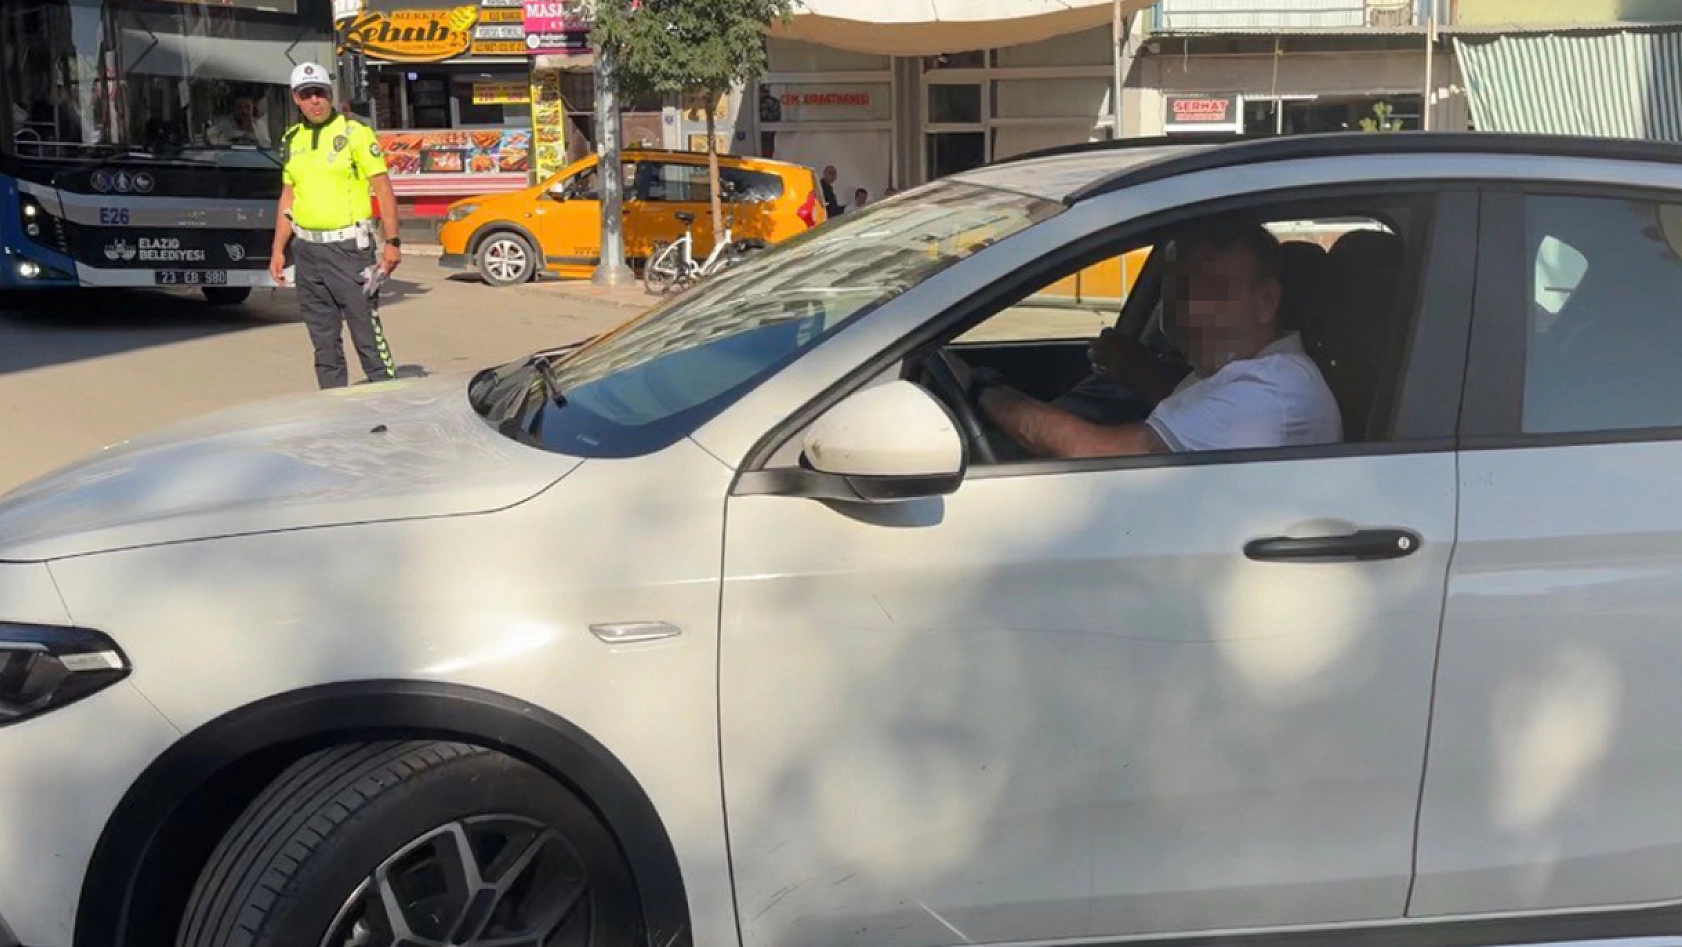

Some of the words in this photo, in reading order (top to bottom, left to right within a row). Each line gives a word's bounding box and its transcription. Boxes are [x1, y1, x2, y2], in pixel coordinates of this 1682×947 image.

[394, 12, 447, 20] MERKEZ
[449, 30, 468, 48] 23
[1174, 101, 1229, 111] SERHAT
[100, 207, 129, 225] E26
[161, 271, 177, 284] 23
[184, 271, 199, 284] EB
[205, 271, 226, 285] 980
